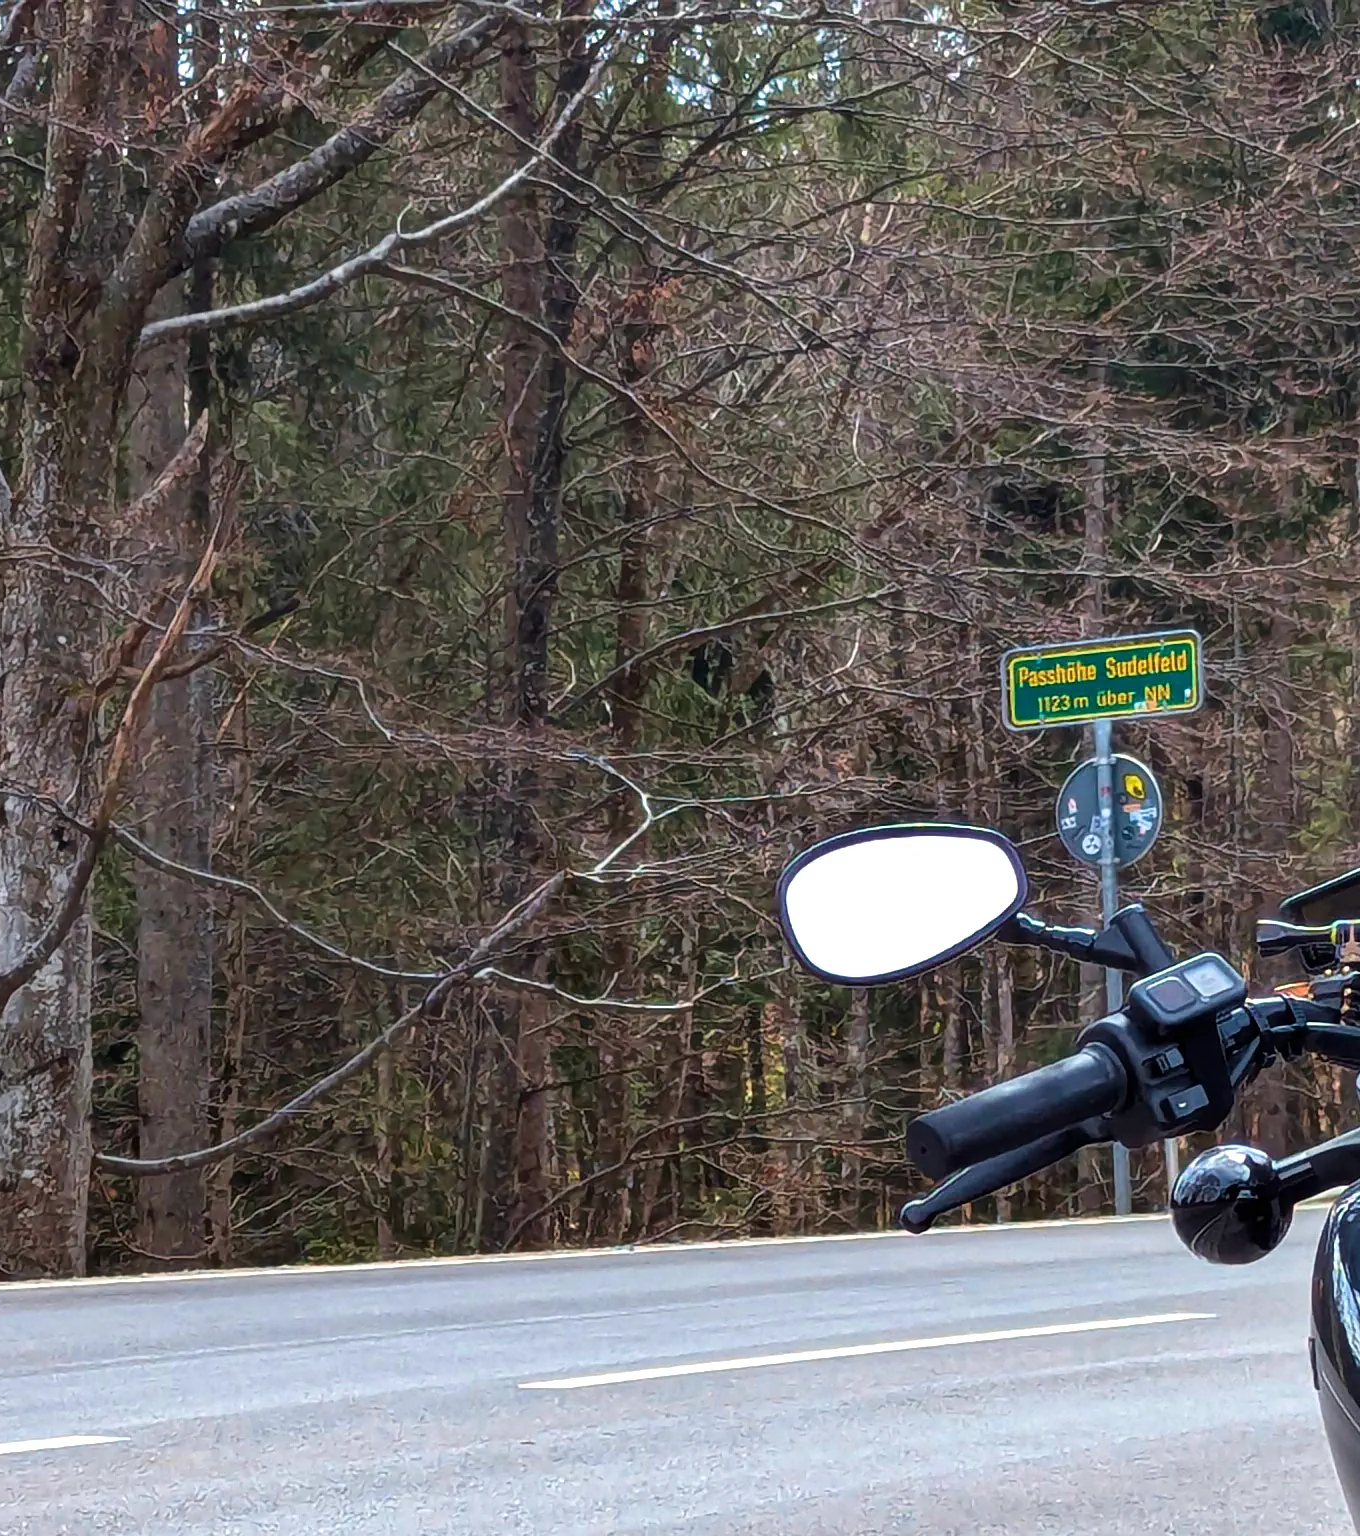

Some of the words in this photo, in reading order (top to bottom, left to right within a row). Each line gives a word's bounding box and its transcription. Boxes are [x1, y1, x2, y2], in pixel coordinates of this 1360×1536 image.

[1018, 660, 1097, 688] Passhöhe
[1105, 649, 1188, 679] Sudelfeld
[1038, 694, 1071, 713] 1123
[1096, 690, 1136, 707] über
[1144, 683, 1171, 705] NN
